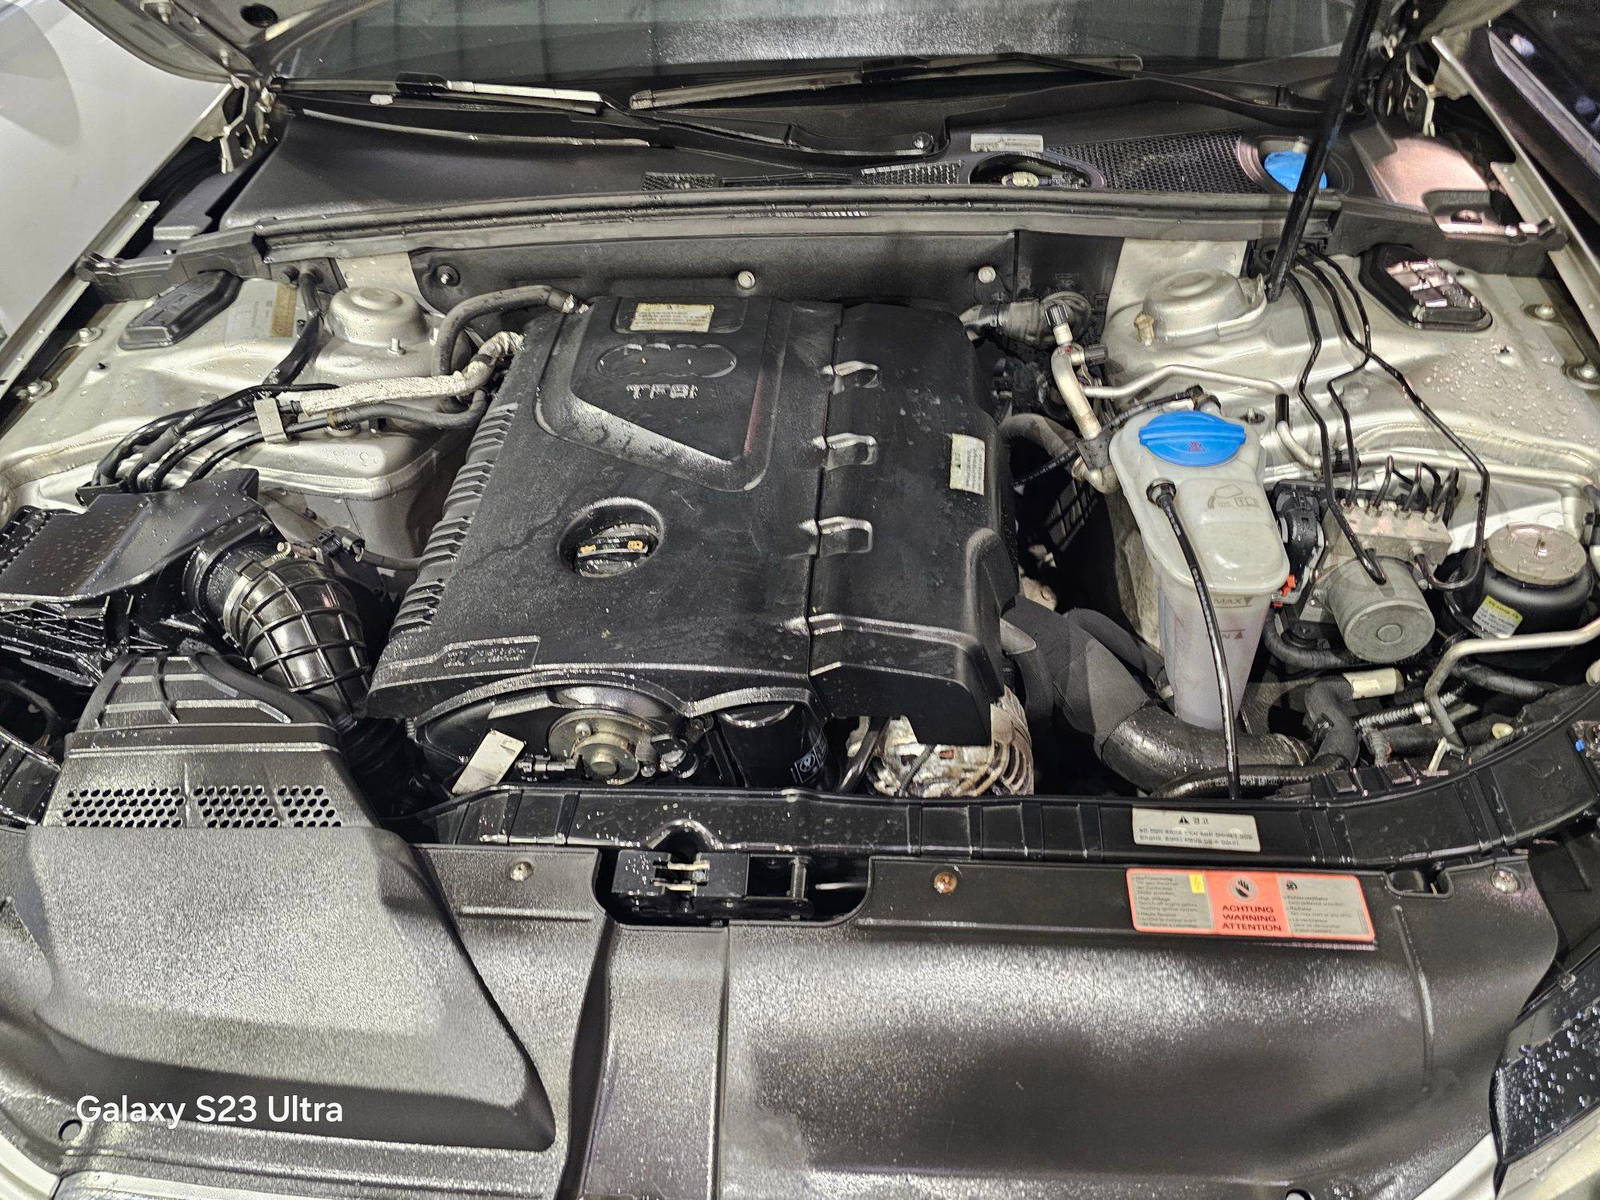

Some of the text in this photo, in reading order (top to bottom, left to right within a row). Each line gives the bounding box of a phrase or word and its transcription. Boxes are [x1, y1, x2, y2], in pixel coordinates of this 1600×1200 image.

[1222, 904, 1274, 913] ACHTUNG
[1222, 913, 1277, 922] WARNING
[1222, 922, 1282, 931] ATTENTION
